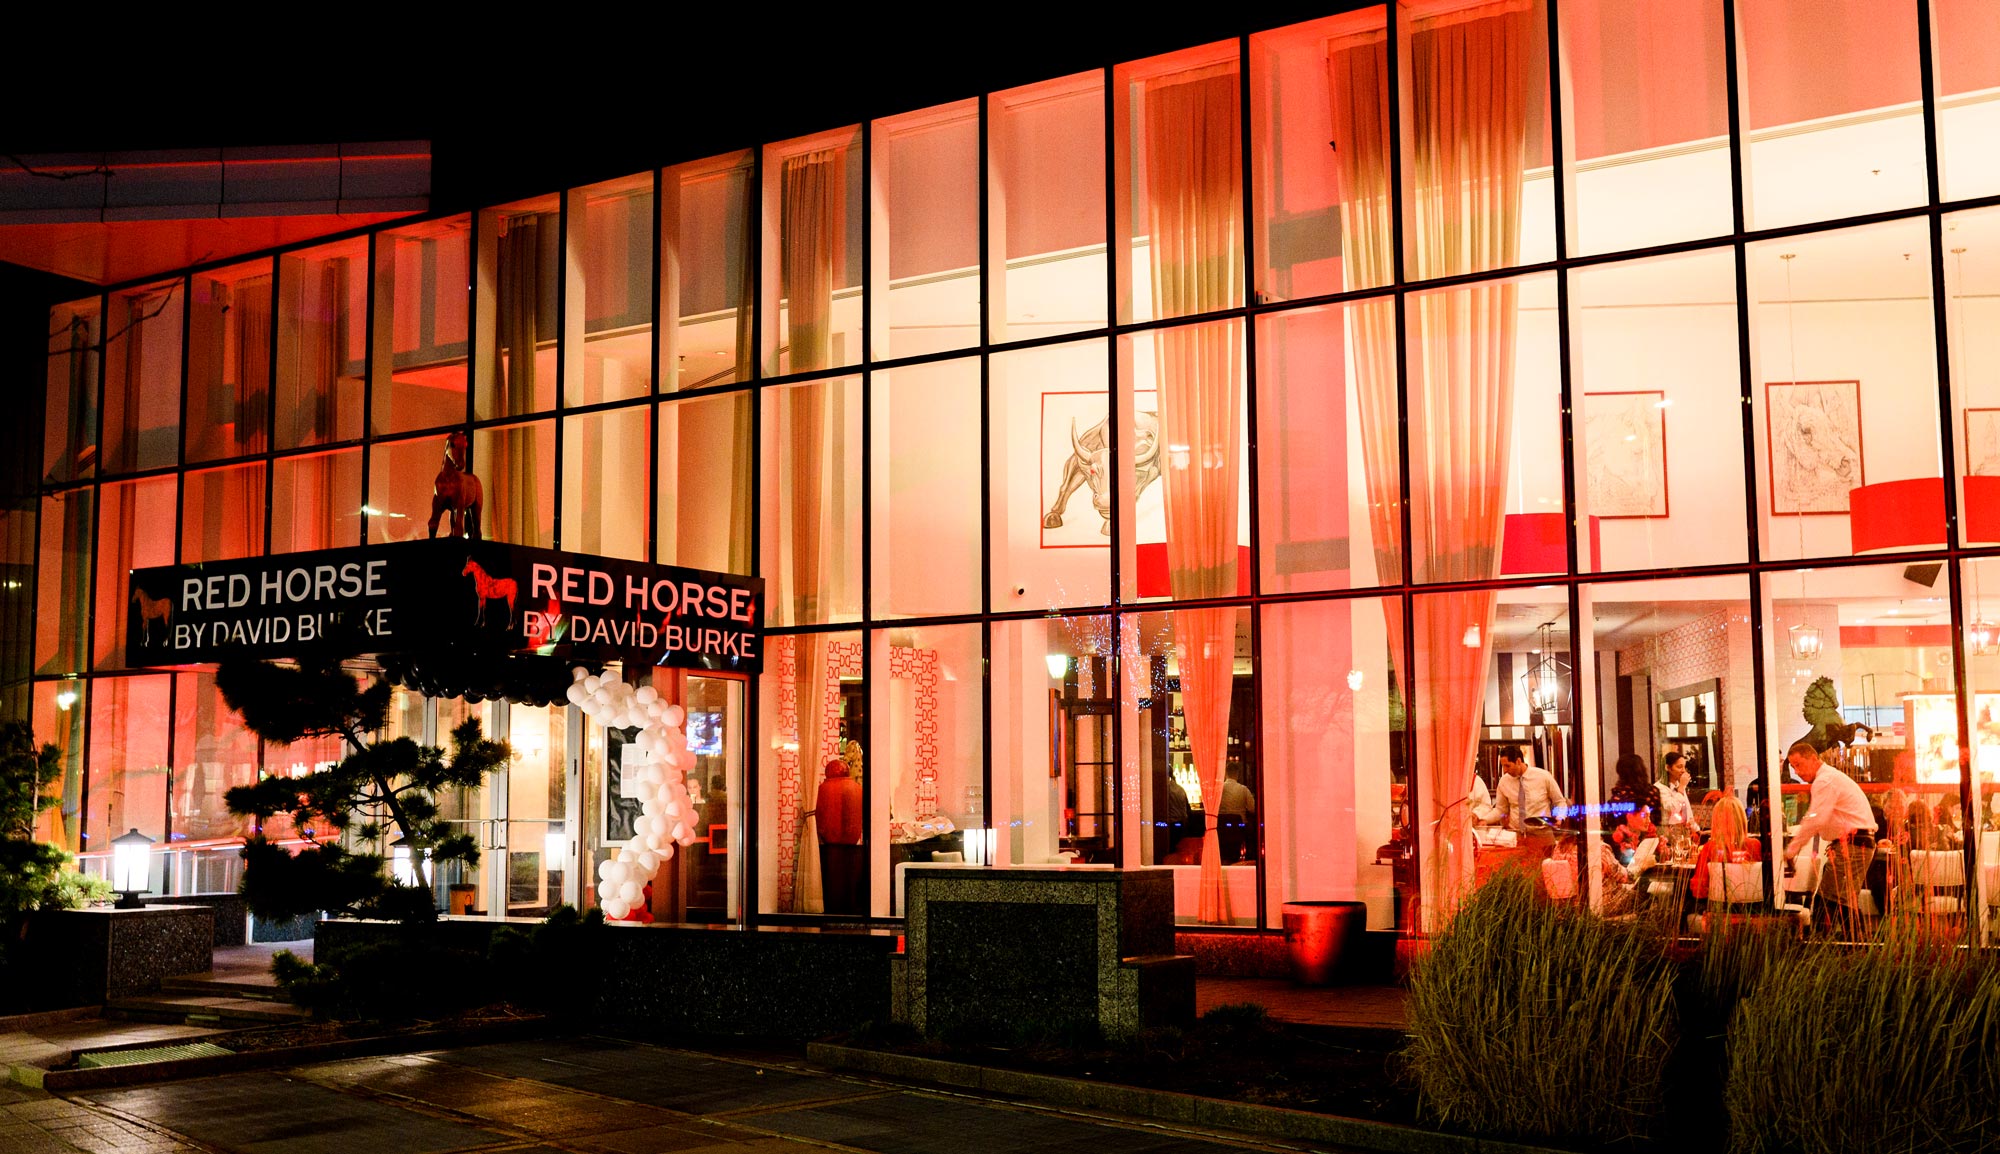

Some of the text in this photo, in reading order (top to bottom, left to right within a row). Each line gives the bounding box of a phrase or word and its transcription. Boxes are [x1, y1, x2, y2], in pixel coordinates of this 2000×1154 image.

[182, 560, 387, 611] RED HORSE
[531, 563, 750, 622] RED HORSE
[175, 622, 206, 649] BY
[212, 616, 291, 646] DAVID
[523, 610, 756, 658] BY DAVID BURKE
